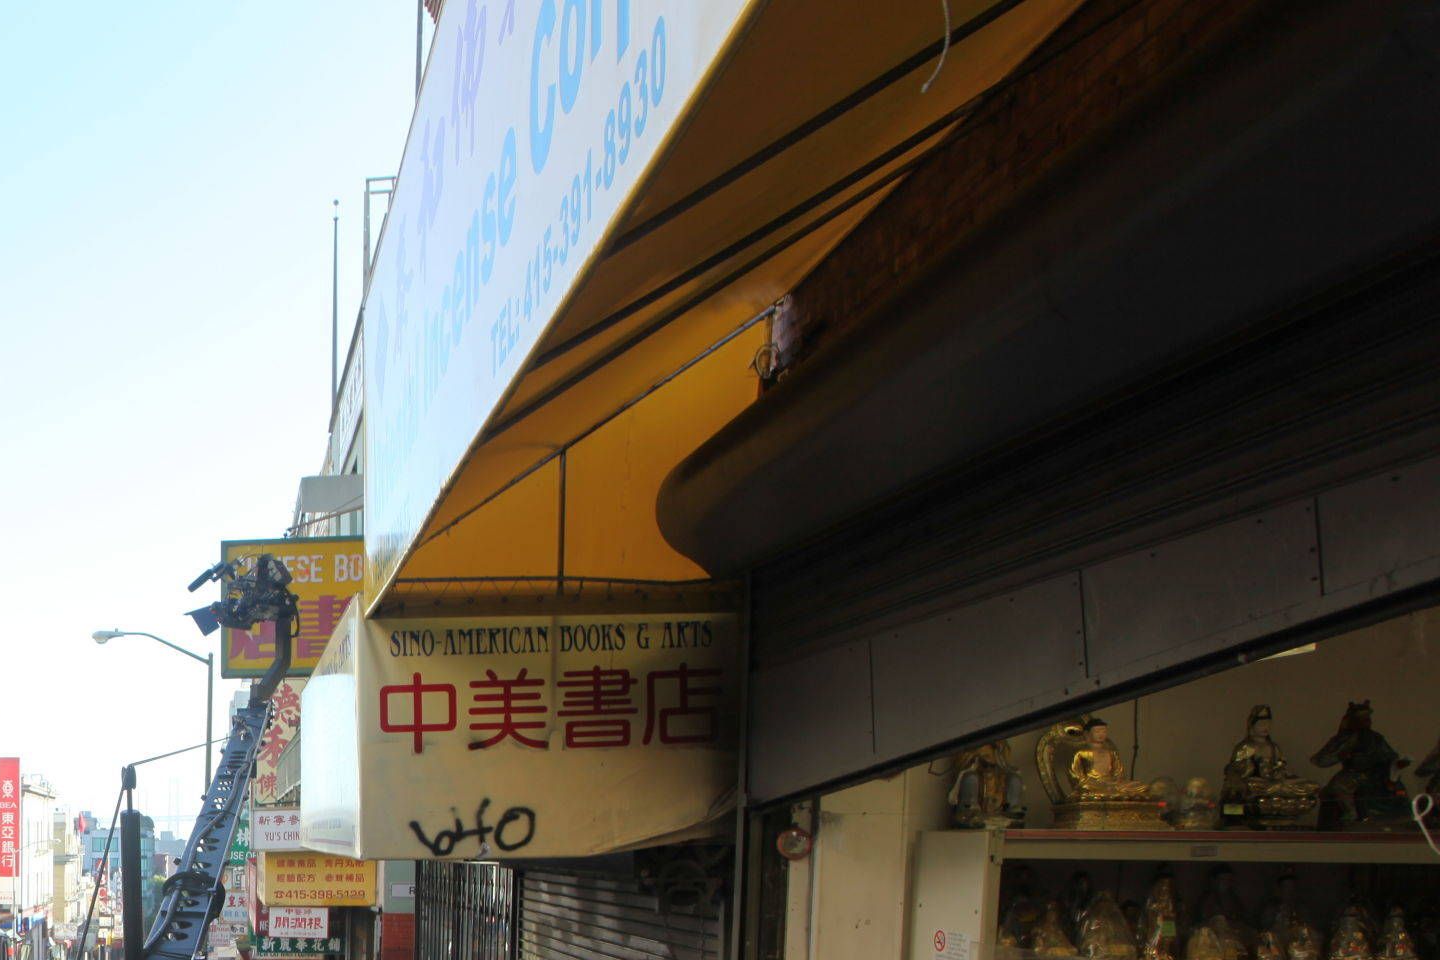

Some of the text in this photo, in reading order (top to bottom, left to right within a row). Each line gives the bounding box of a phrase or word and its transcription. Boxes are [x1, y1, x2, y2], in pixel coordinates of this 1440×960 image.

[530, 0, 631, 176] Co
[491, 15, 667, 378] TEL: 415-391-8930
[334, 553, 363, 583] BO
[390, 625, 550, 657] SINO-AMERICAN
[560, 622, 626, 652] BOOKS
[661, 619, 713, 649] ARTS
[379, 662, 724, 755] 中美書店
[1, 812, 15, 867] 東亞銀行
[265, 831, 300, 841] YU'S CHIN
